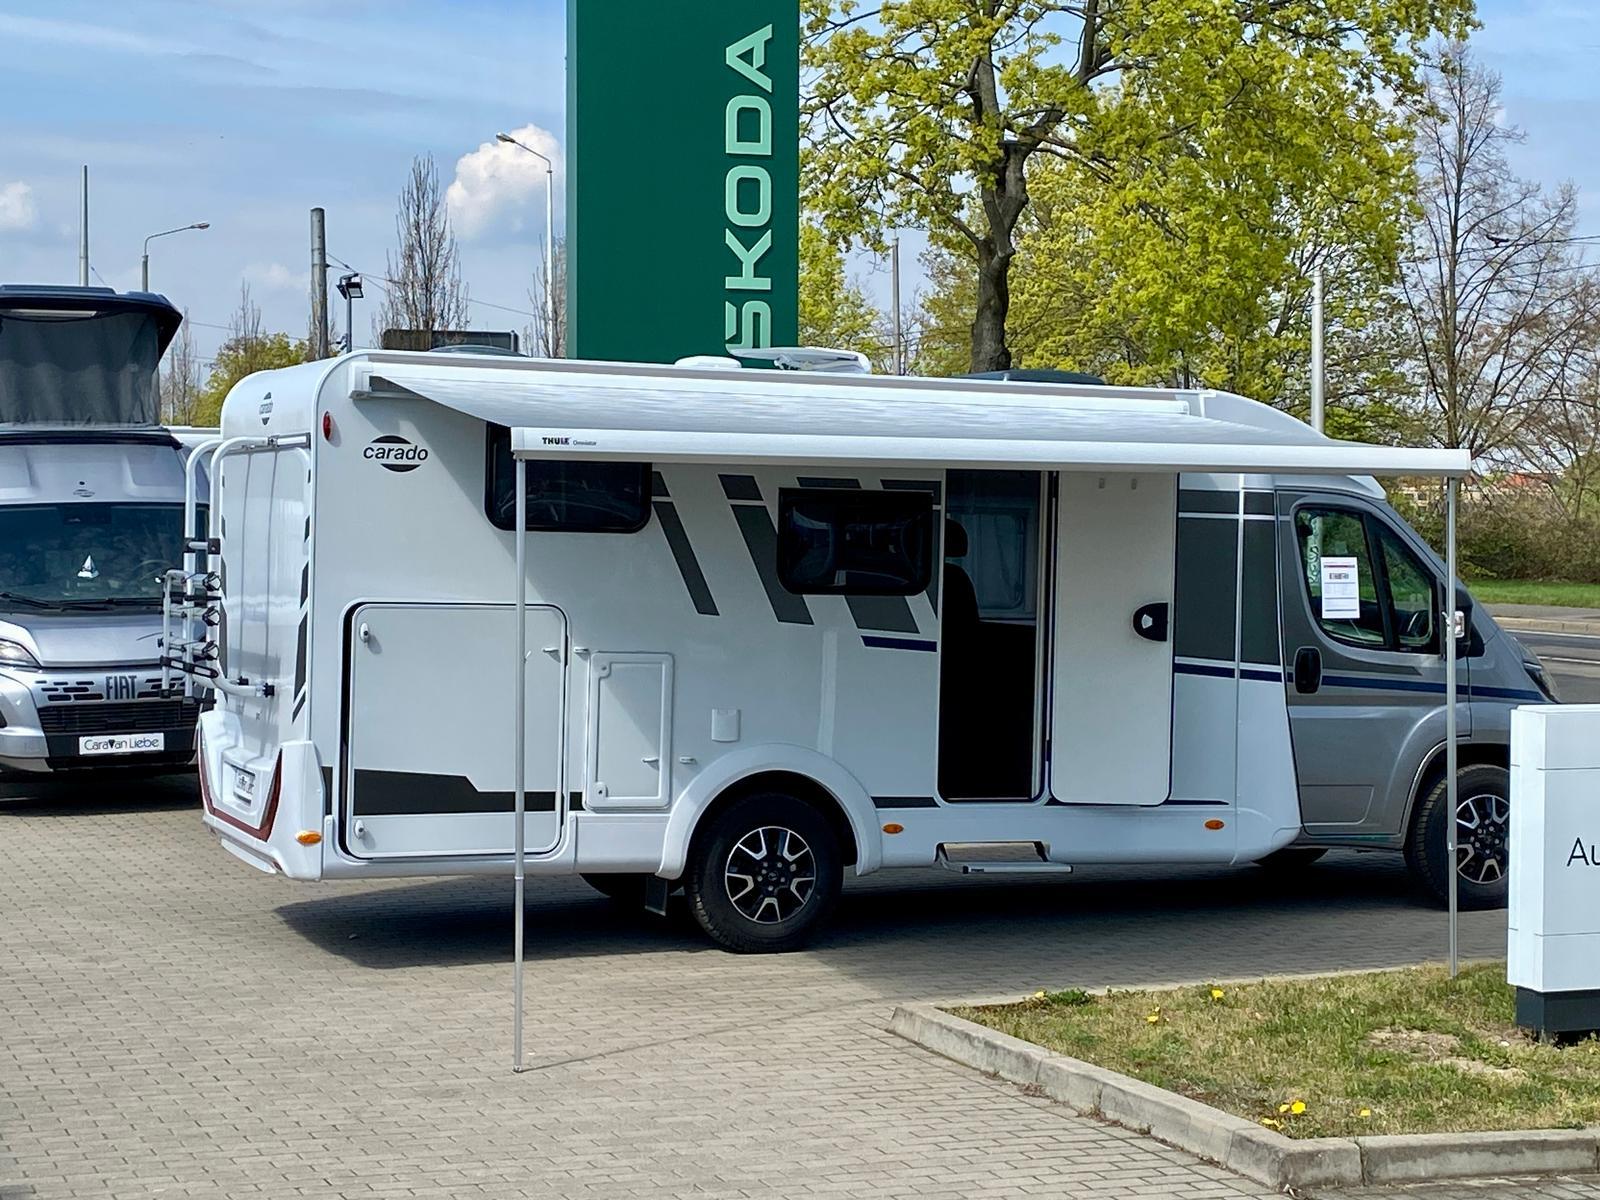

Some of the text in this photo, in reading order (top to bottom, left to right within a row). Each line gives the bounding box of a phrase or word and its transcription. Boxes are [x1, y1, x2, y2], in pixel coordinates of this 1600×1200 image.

[542, 437, 570, 445] THULE
[363, 445, 428, 461] carado
[105, 675, 137, 700] FIAT
